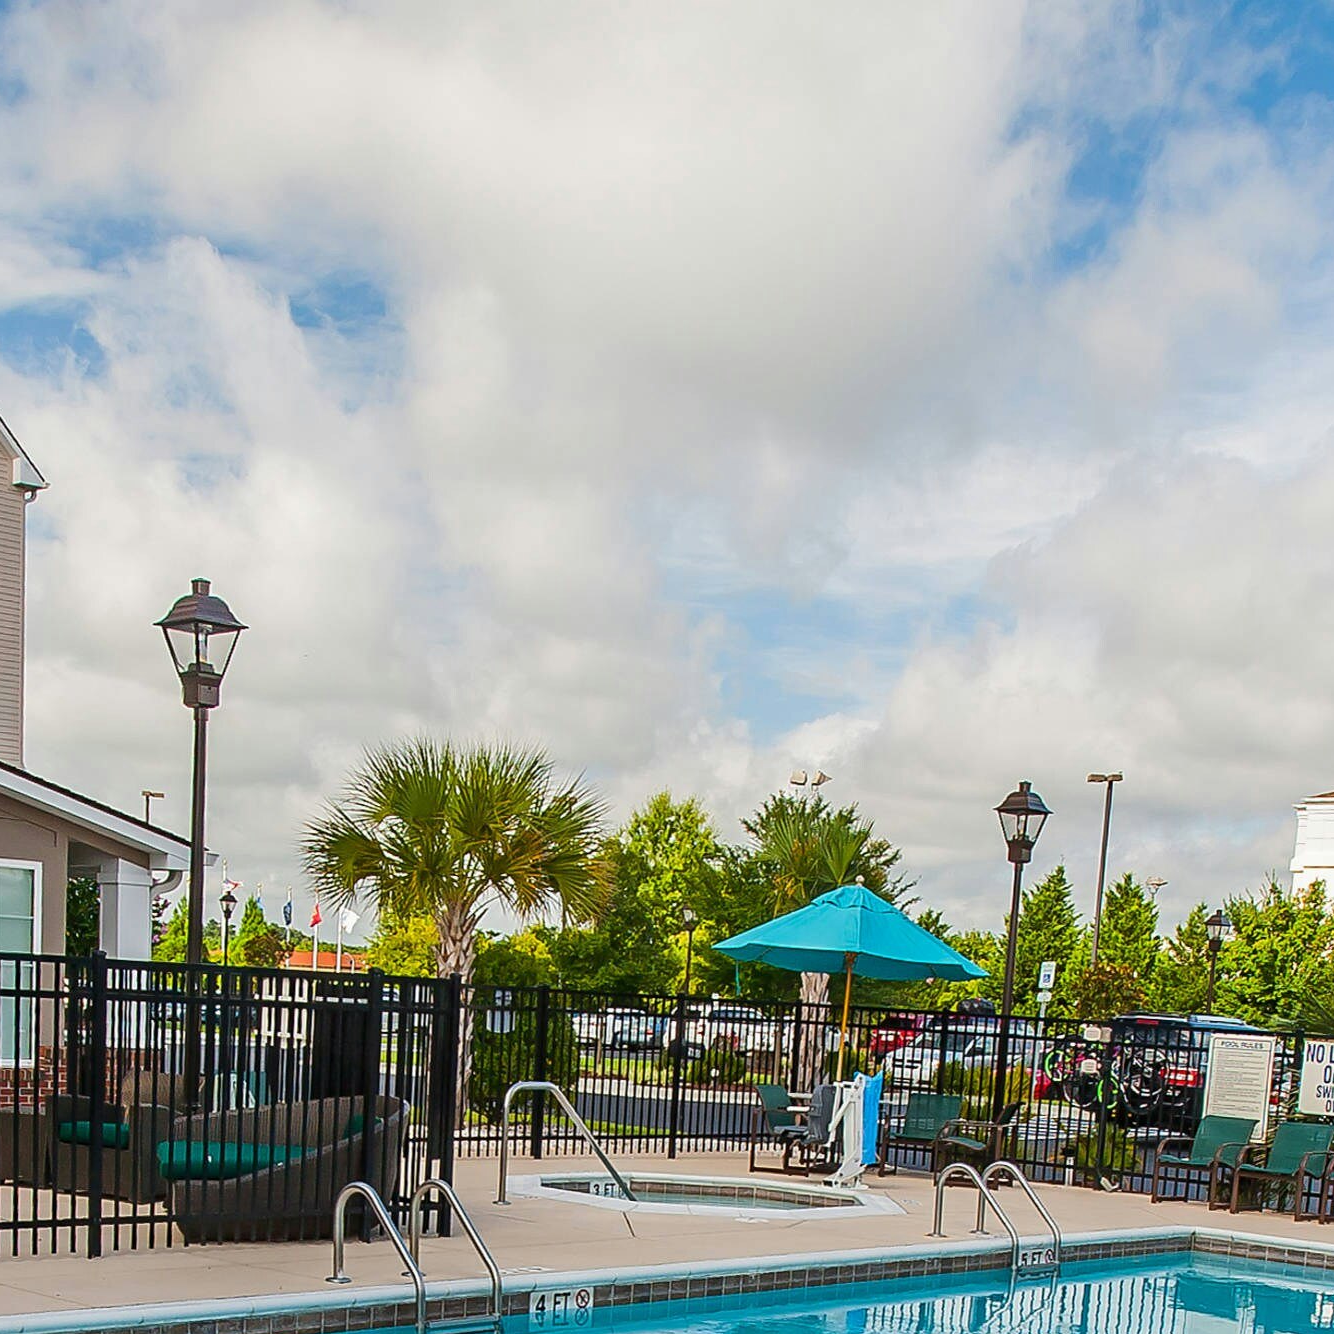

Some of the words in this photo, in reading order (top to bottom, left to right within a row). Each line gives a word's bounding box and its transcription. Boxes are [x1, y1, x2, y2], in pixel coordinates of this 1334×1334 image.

[1307, 1044, 1325, 1063] NO
[604, 1183, 616, 1196] FT
[1022, 1253, 1028, 1266] 5
[1032, 1252, 1042, 1265] FT
[535, 1294, 546, 1312] 4
[553, 1292, 571, 1311] FT
